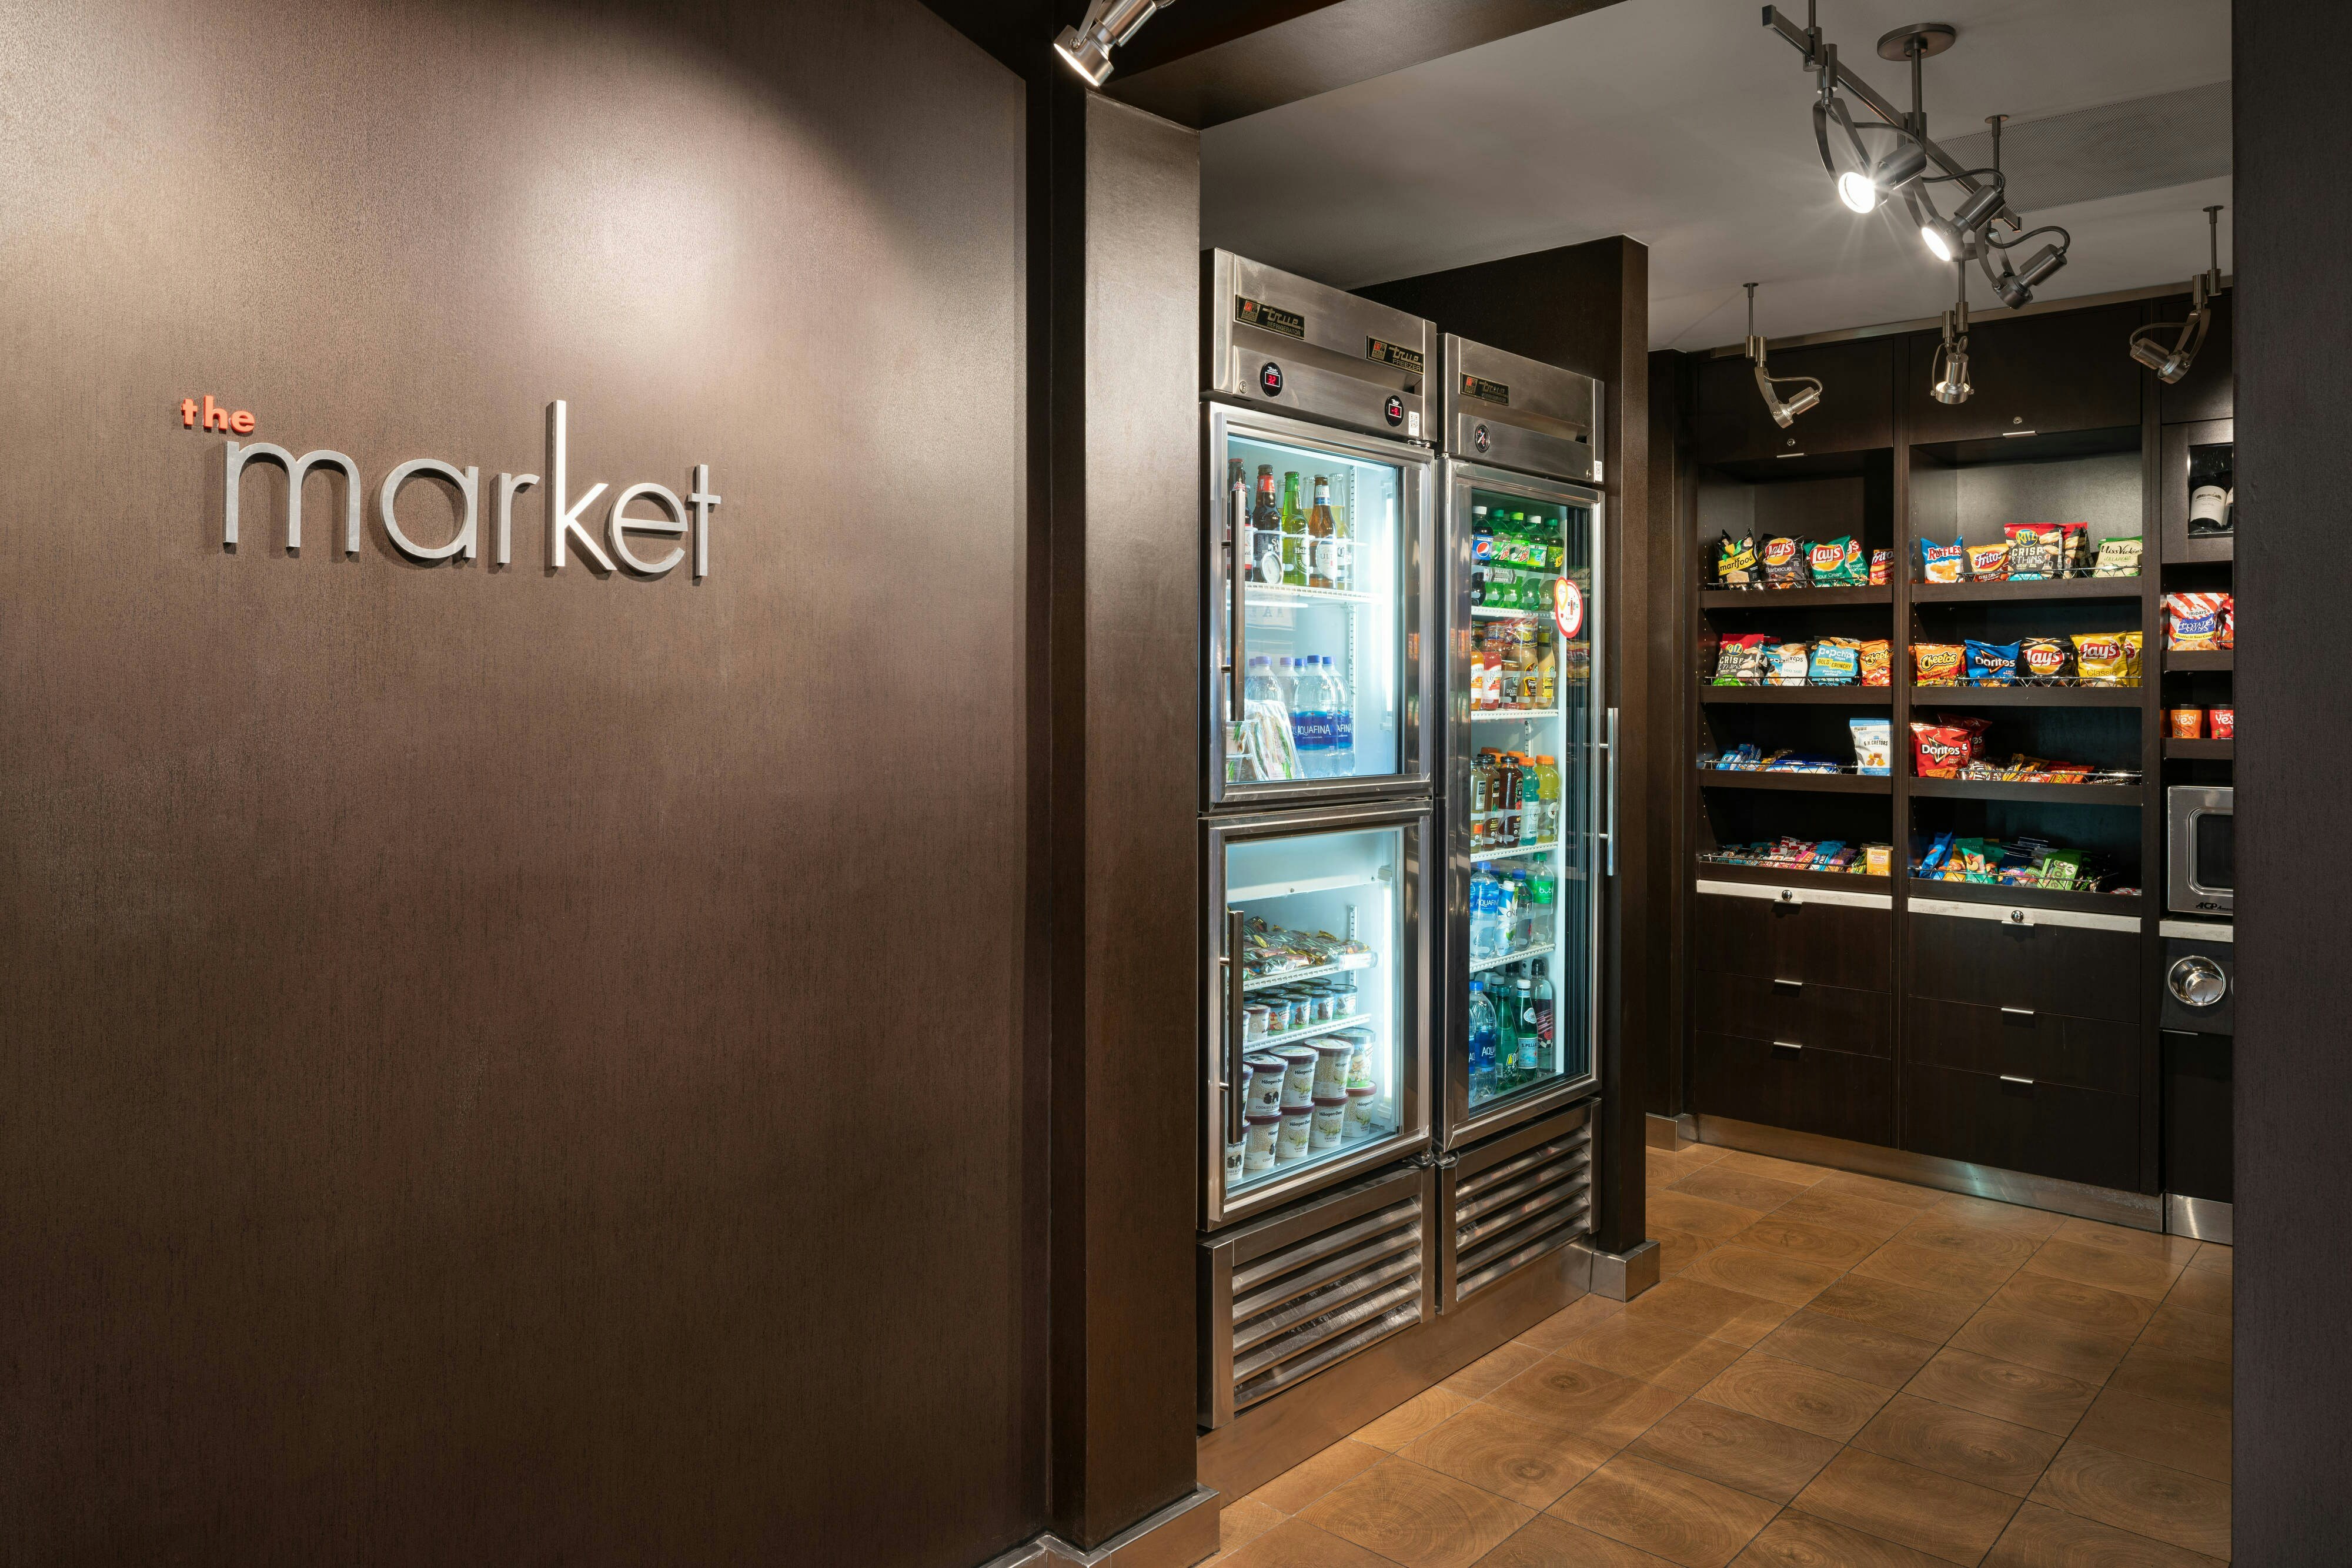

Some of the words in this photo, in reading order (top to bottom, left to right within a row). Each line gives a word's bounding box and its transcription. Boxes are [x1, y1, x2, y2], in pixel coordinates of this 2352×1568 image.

[1267, 321, 1301, 336] REFRIGERATOR
[1393, 359, 1421, 372] FREEZER
[1268, 375, 1276, 385] 32
[181, 395, 255, 433] the
[223, 399, 721, 577] market
[2017, 531, 2036, 544] RITZ
[1872, 551, 1894, 564] Frito
[1927, 546, 1962, 561] RUFFLES
[2012, 547, 2044, 556] CRISP
[1975, 552, 2003, 569] Fritos
[2016, 556, 2044, 564] THINS
[1818, 648, 1855, 659] popchips
[1921, 652, 1957, 670] Cheetos
[1975, 656, 2016, 667] Doritos
[2174, 714, 2196, 724] Yes!
[1298, 724, 1331, 736] AQUAFINA
[1337, 723, 1352, 734] AFINA
[1922, 744, 1960, 755] Doritos
[2051, 860, 2065, 888] grae
[1476, 899, 1498, 907] AQUAFIN
